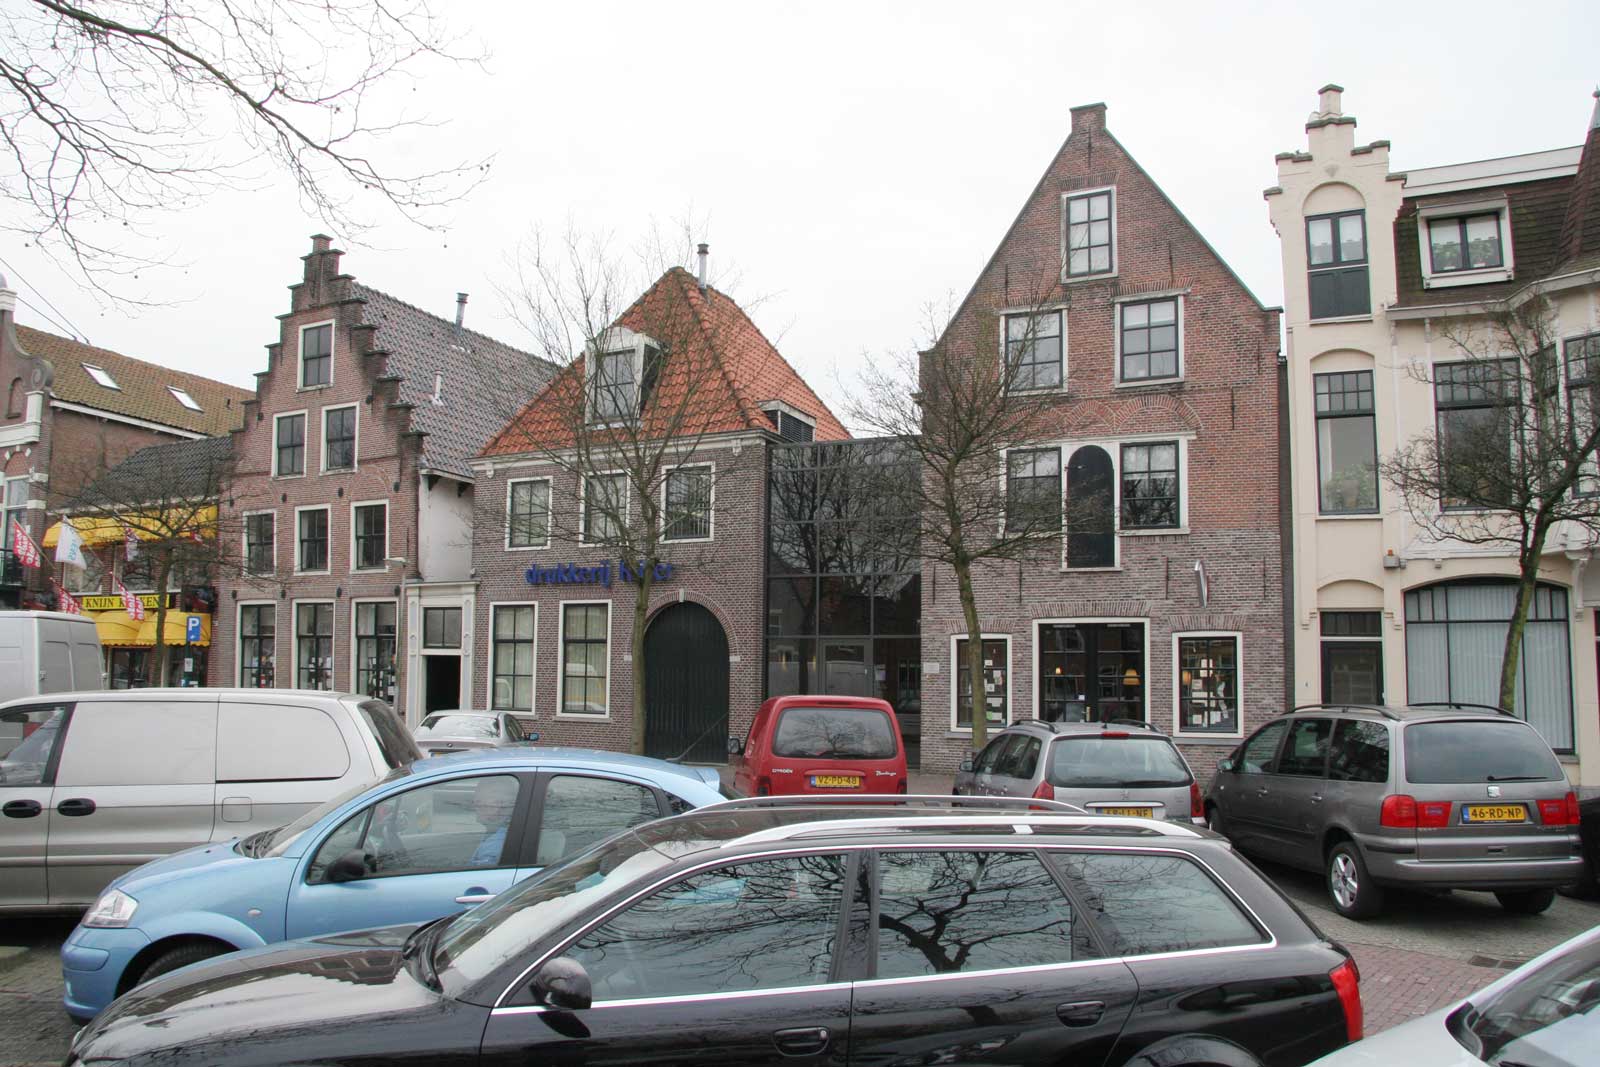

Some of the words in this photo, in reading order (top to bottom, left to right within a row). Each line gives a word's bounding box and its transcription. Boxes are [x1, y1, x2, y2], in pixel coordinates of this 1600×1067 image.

[86, 597, 114, 608] KNIJN
[188, 618, 200, 631] P
[1471, 807, 1522, 819] 46-RD-NP
